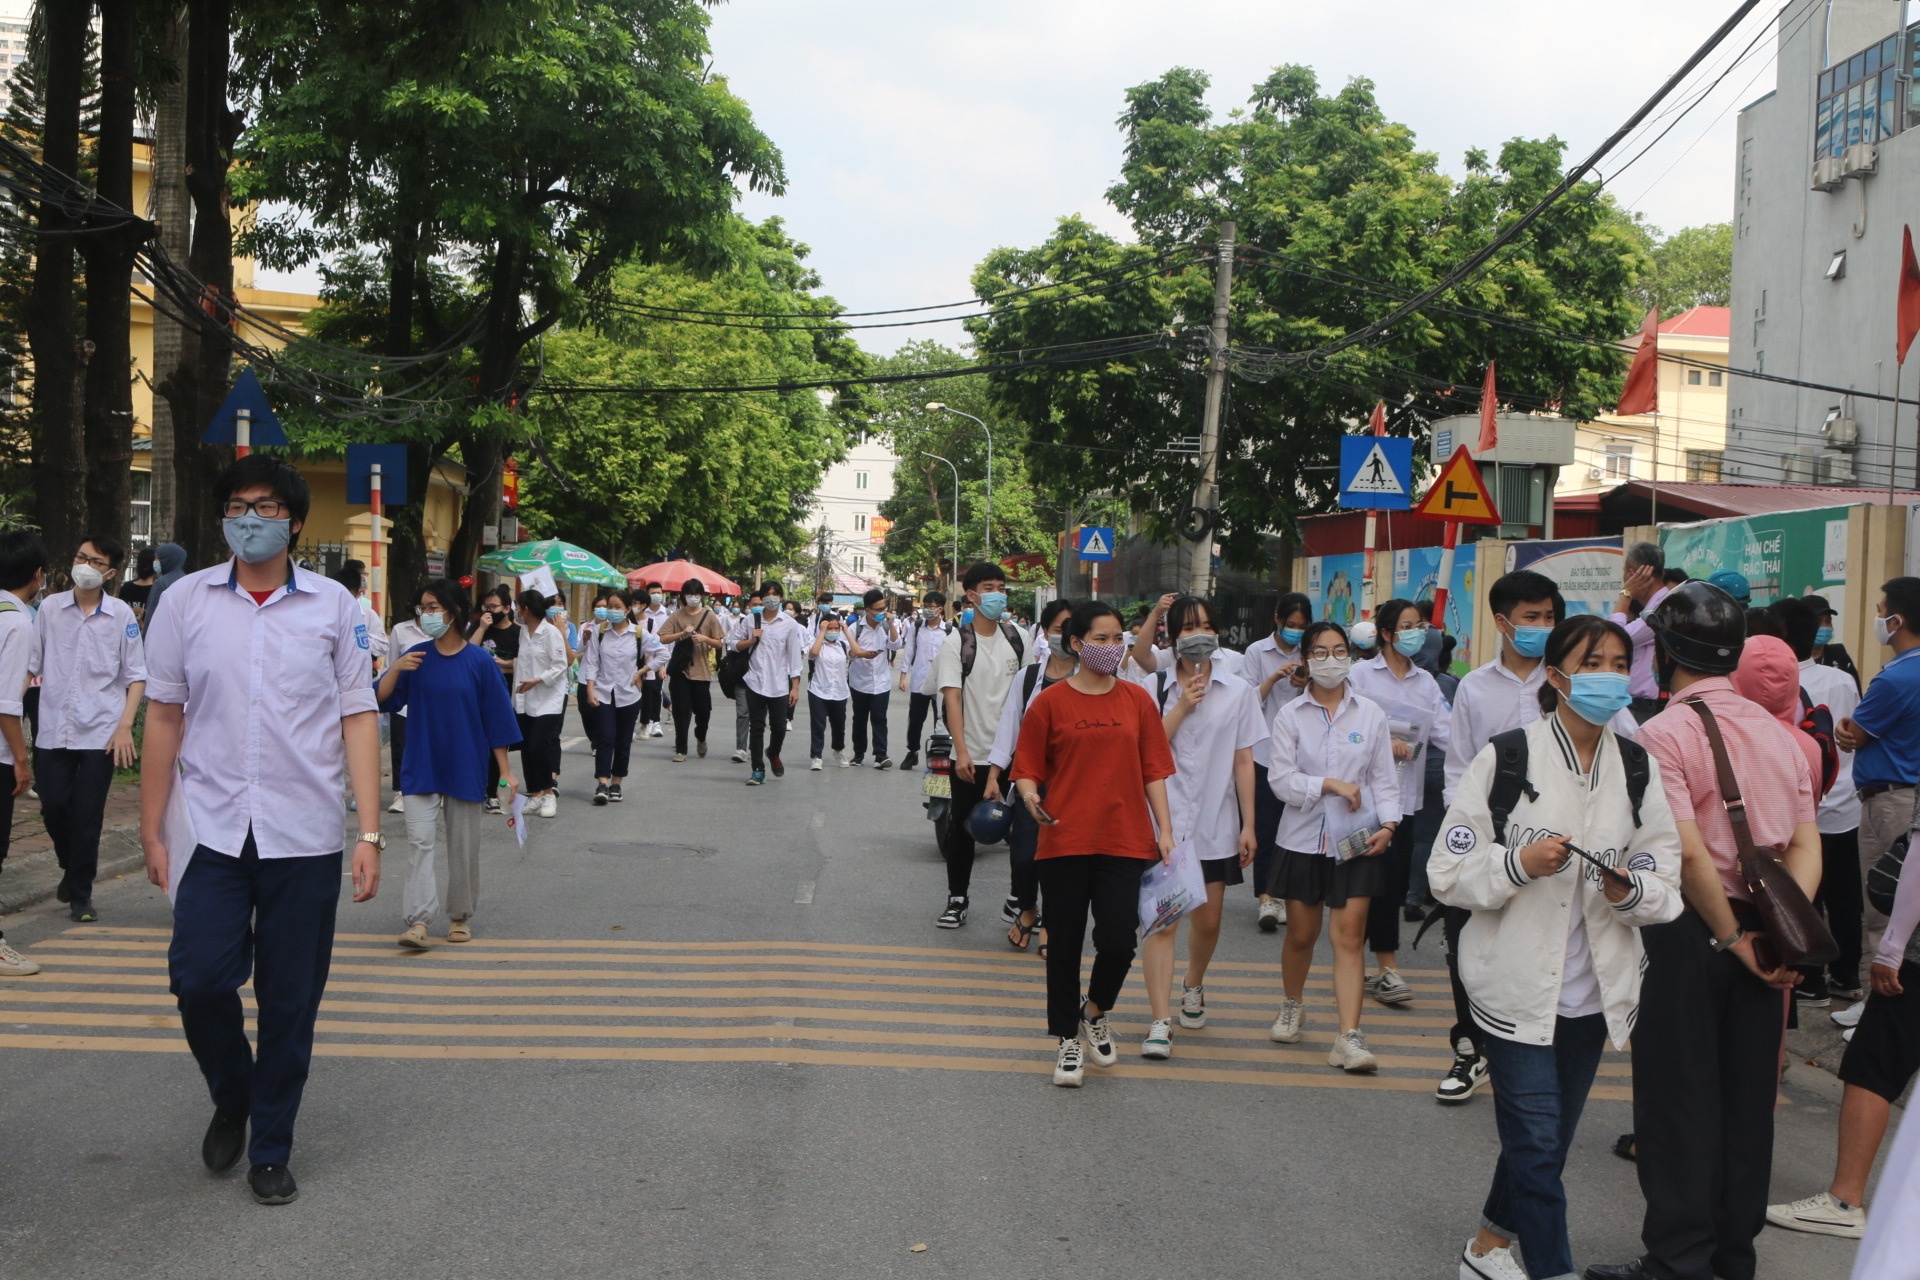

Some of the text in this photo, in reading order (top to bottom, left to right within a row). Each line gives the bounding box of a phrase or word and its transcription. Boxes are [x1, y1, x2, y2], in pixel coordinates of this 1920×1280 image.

[1744, 534, 1781, 557] HẠN CHẾ
[1743, 556, 1781, 577] RÁC THẢI
[1749, 578, 1780, 602] HỰA
